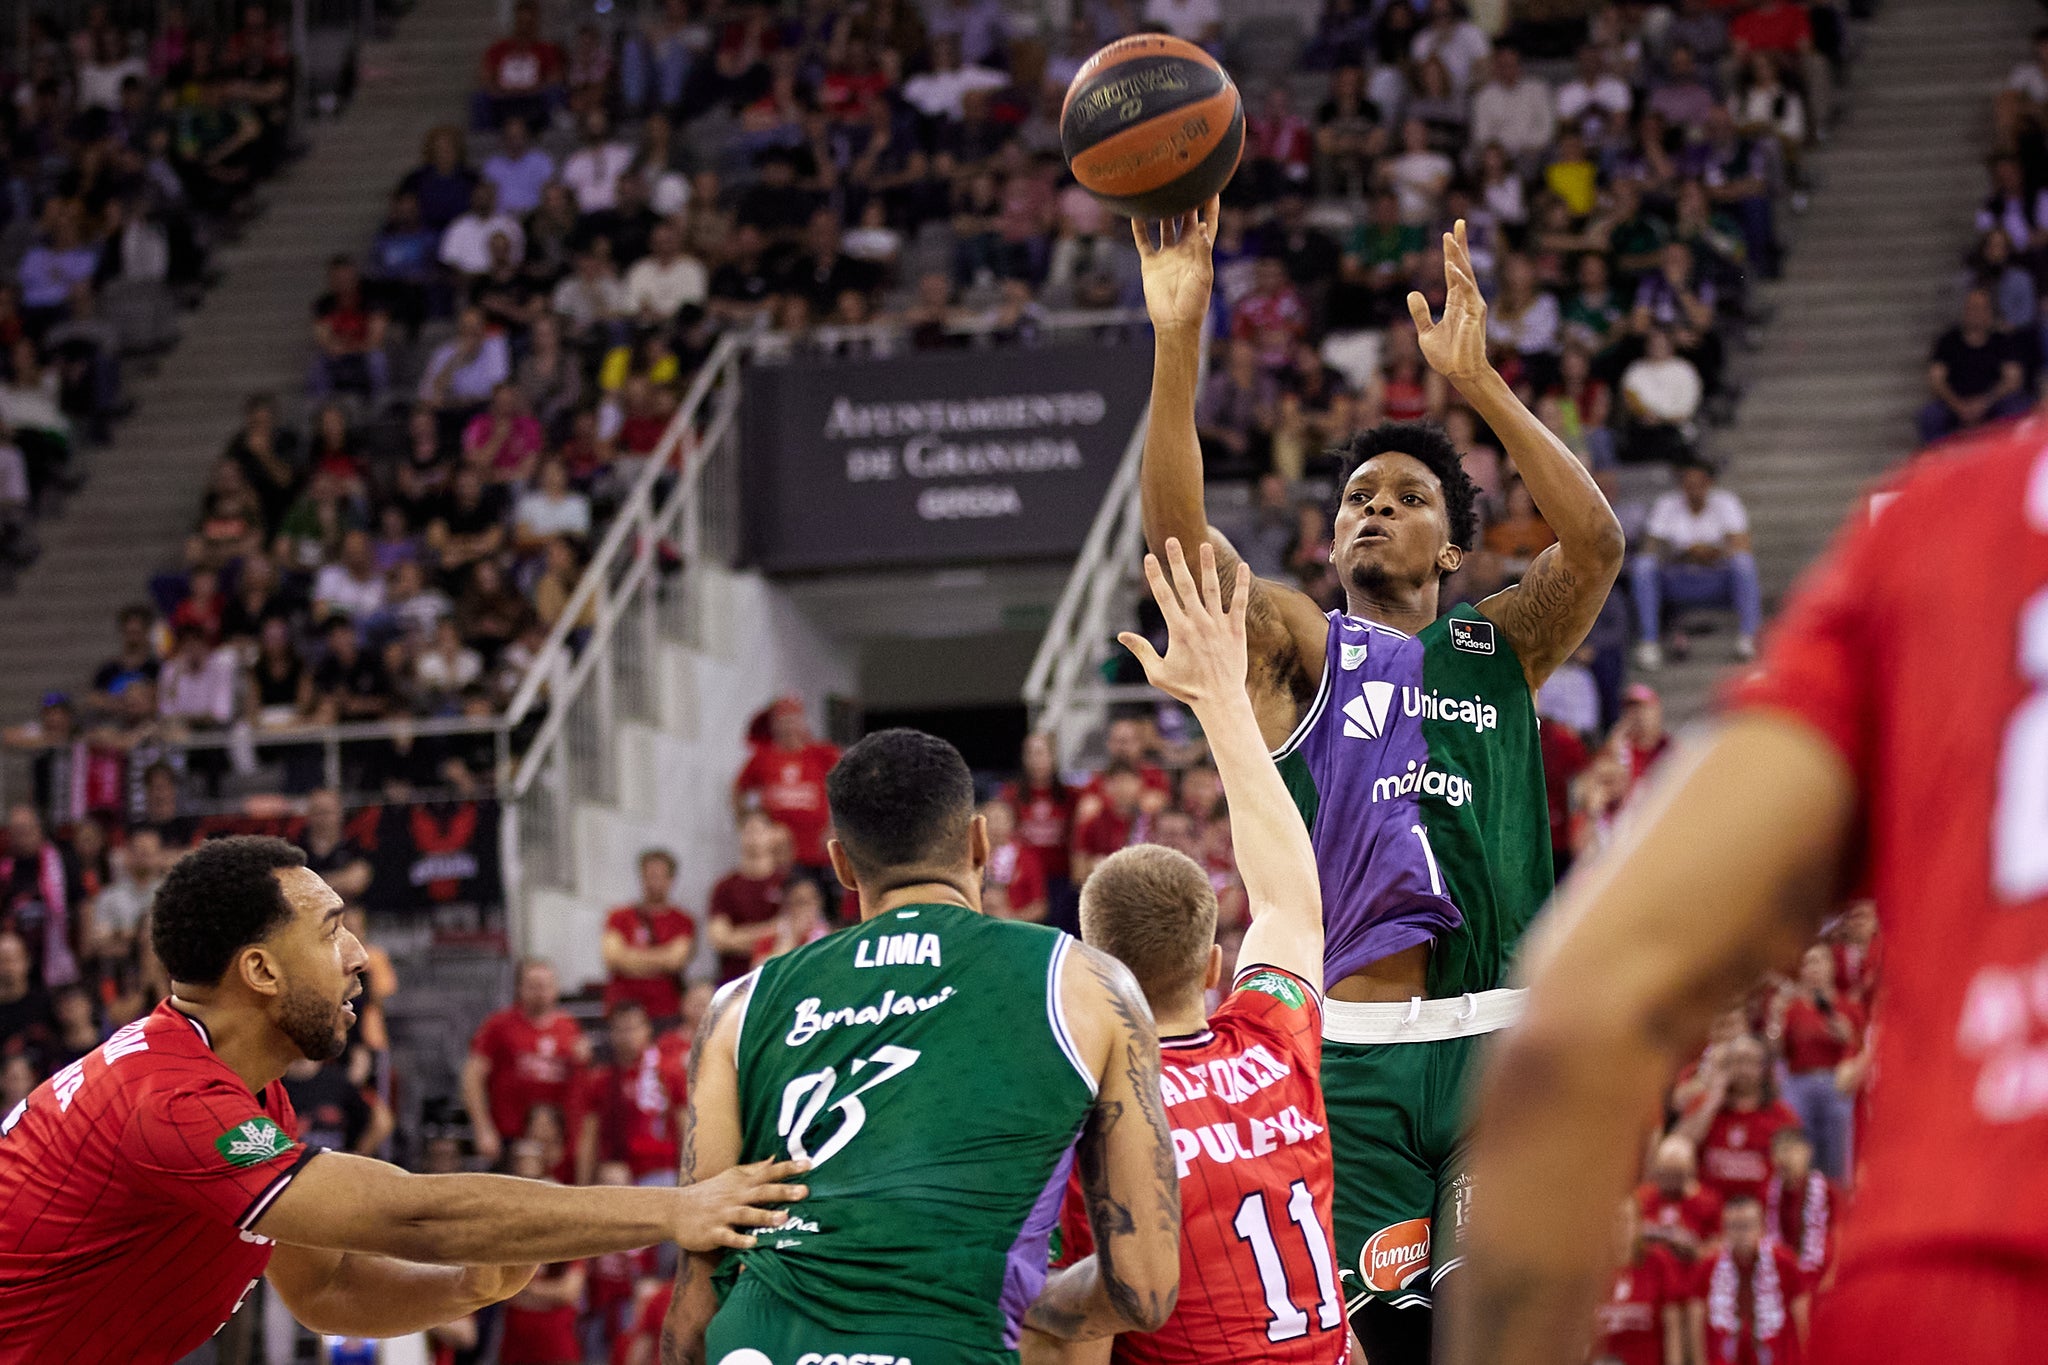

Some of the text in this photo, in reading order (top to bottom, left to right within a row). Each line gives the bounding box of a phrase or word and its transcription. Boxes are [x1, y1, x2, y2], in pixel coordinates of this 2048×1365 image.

[846, 433, 1083, 482] DE GRANADA
[1454, 628, 1471, 640] liga
[1455, 638, 1491, 650] endesa
[1402, 686, 1498, 733] Unicaja
[1372, 759, 1473, 807] málaga
[853, 932, 942, 969] LIMA
[1170, 1105, 1325, 1179] PULEVA
[1232, 1178, 1342, 1344] 11
